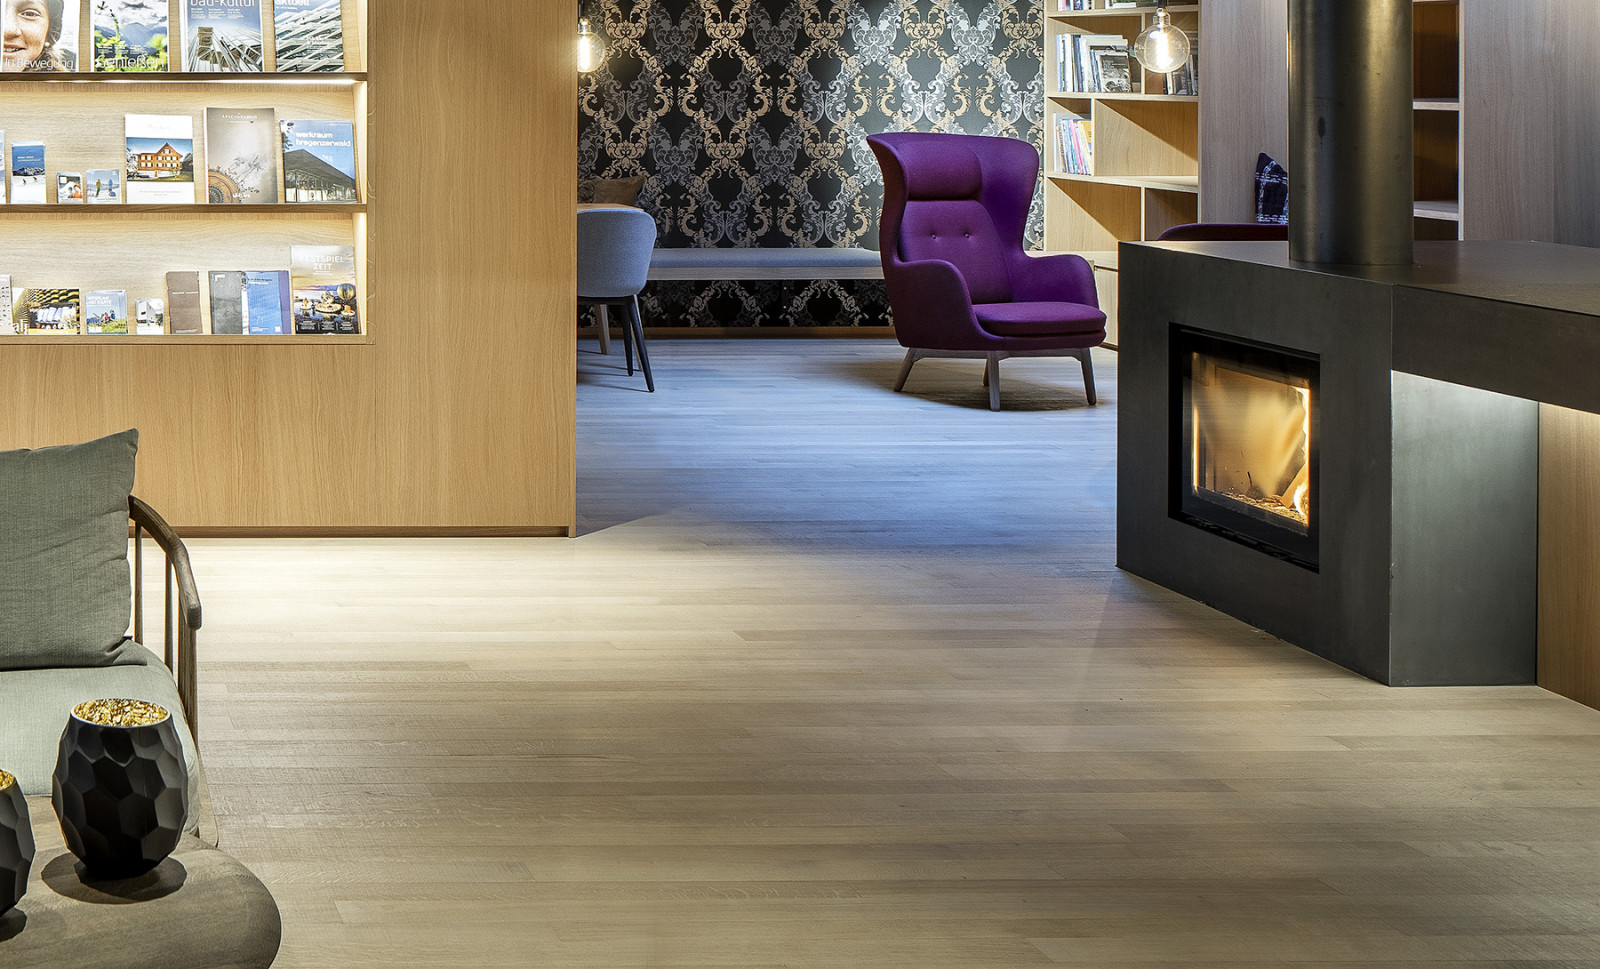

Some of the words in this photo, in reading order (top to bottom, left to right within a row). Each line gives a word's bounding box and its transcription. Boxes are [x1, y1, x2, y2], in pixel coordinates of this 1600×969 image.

[5, 57, 15, 68] In
[16, 57, 74, 71] Bewegung
[96, 54, 164, 69] Genießen
[295, 139, 352, 148] bregenzerwald
